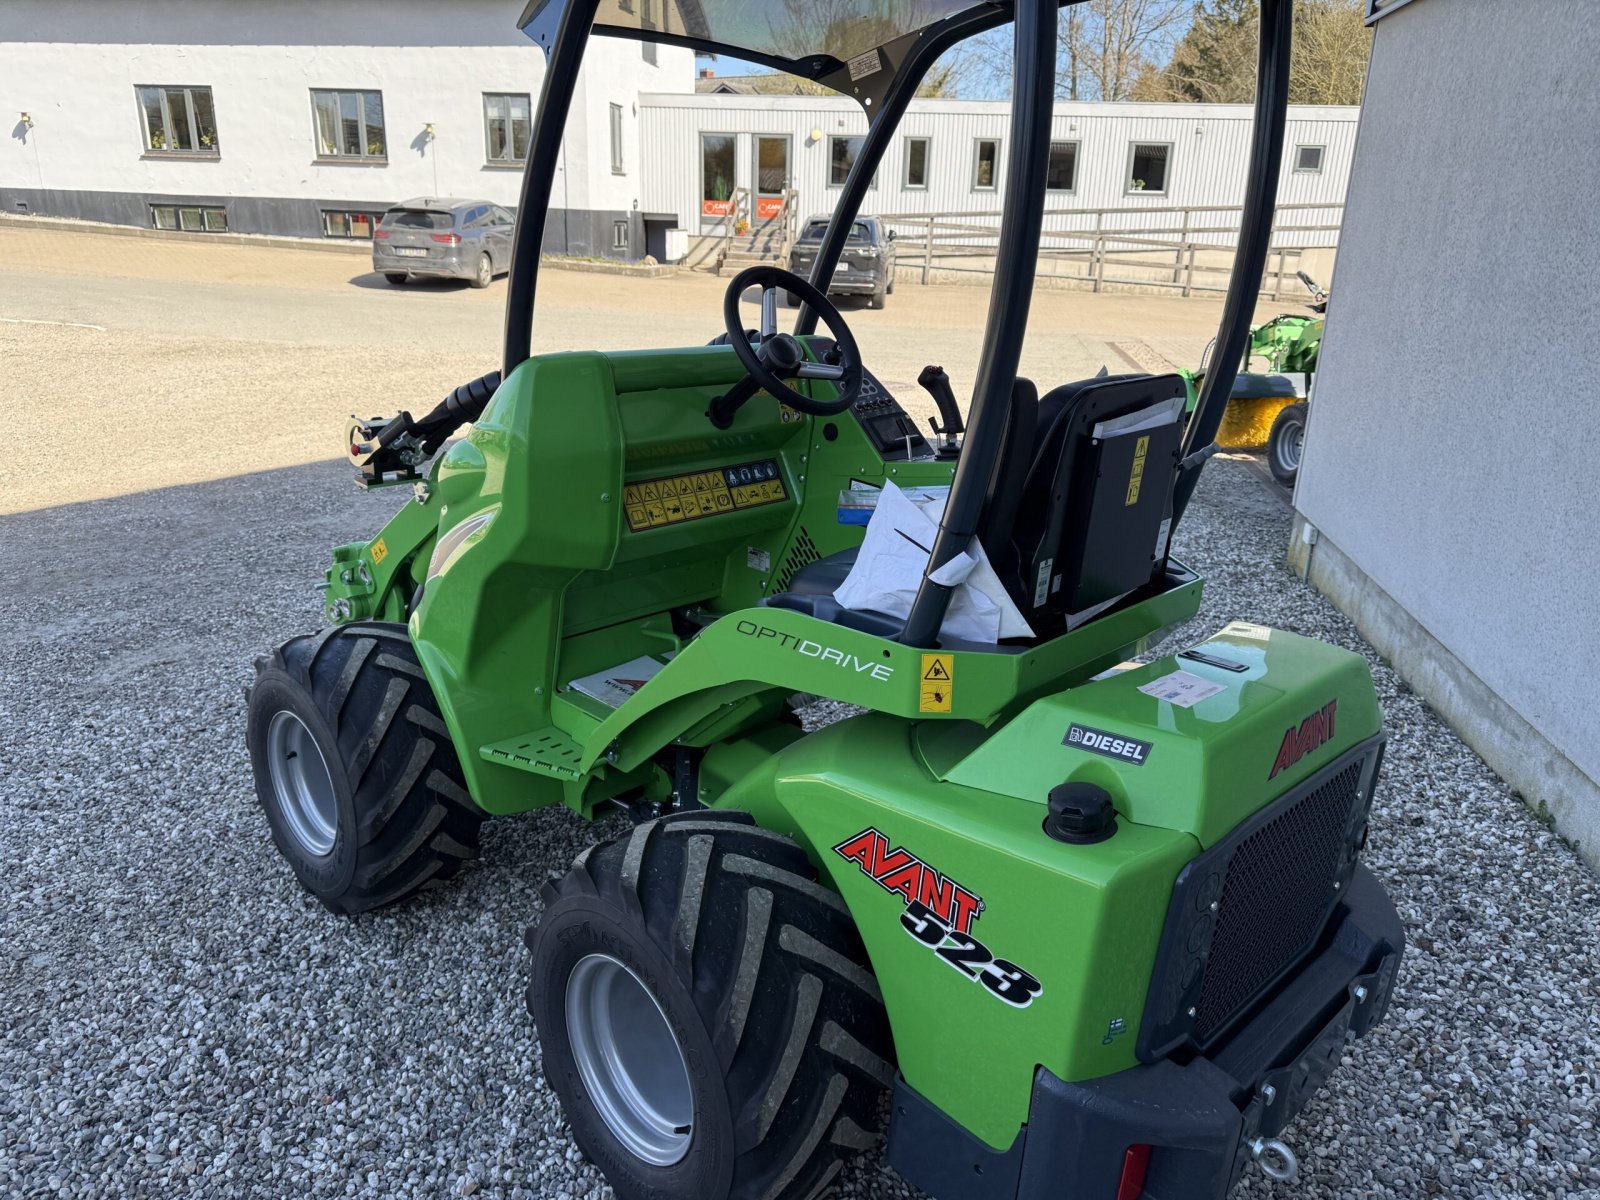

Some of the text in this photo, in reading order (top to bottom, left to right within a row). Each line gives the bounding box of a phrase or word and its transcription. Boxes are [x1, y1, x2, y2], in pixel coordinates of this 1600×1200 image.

[736, 619, 894, 682] OPTIDRIVE
[1081, 731, 1143, 760] DIESEL
[1267, 698, 1337, 781] AVANT
[899, 898, 1043, 1008] 523
